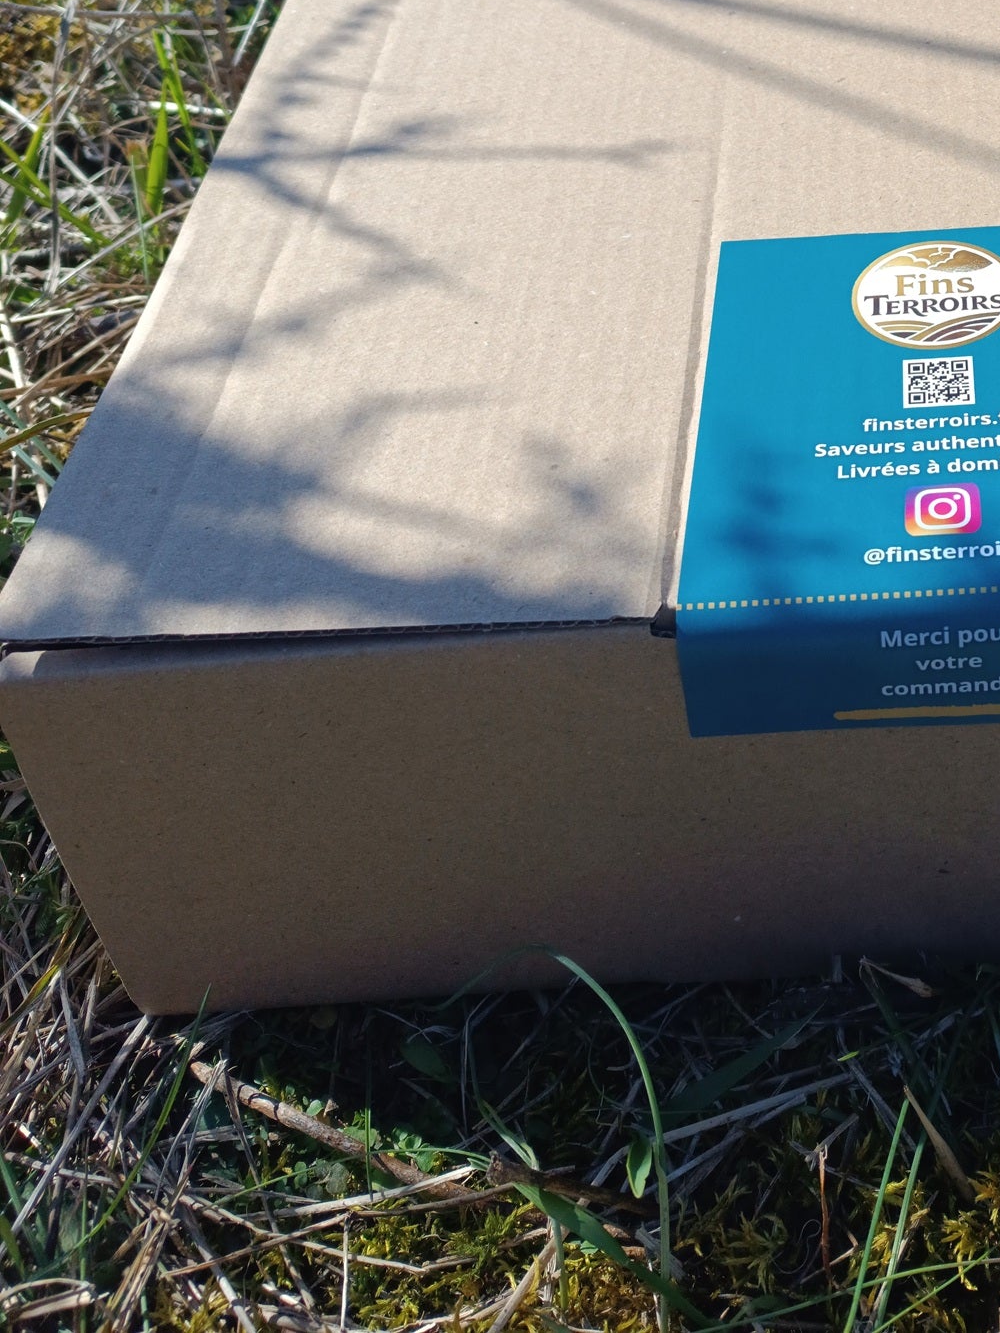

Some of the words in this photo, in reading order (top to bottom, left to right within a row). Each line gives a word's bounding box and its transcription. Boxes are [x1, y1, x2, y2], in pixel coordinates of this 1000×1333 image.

[894, 273, 975, 297] Fins
[814, 442, 906, 458] Saveurs
[837, 461, 921, 479] Livrées
[926, 459, 940, 474] à
[879, 626, 951, 648] Merci
[915, 653, 984, 671] votre
